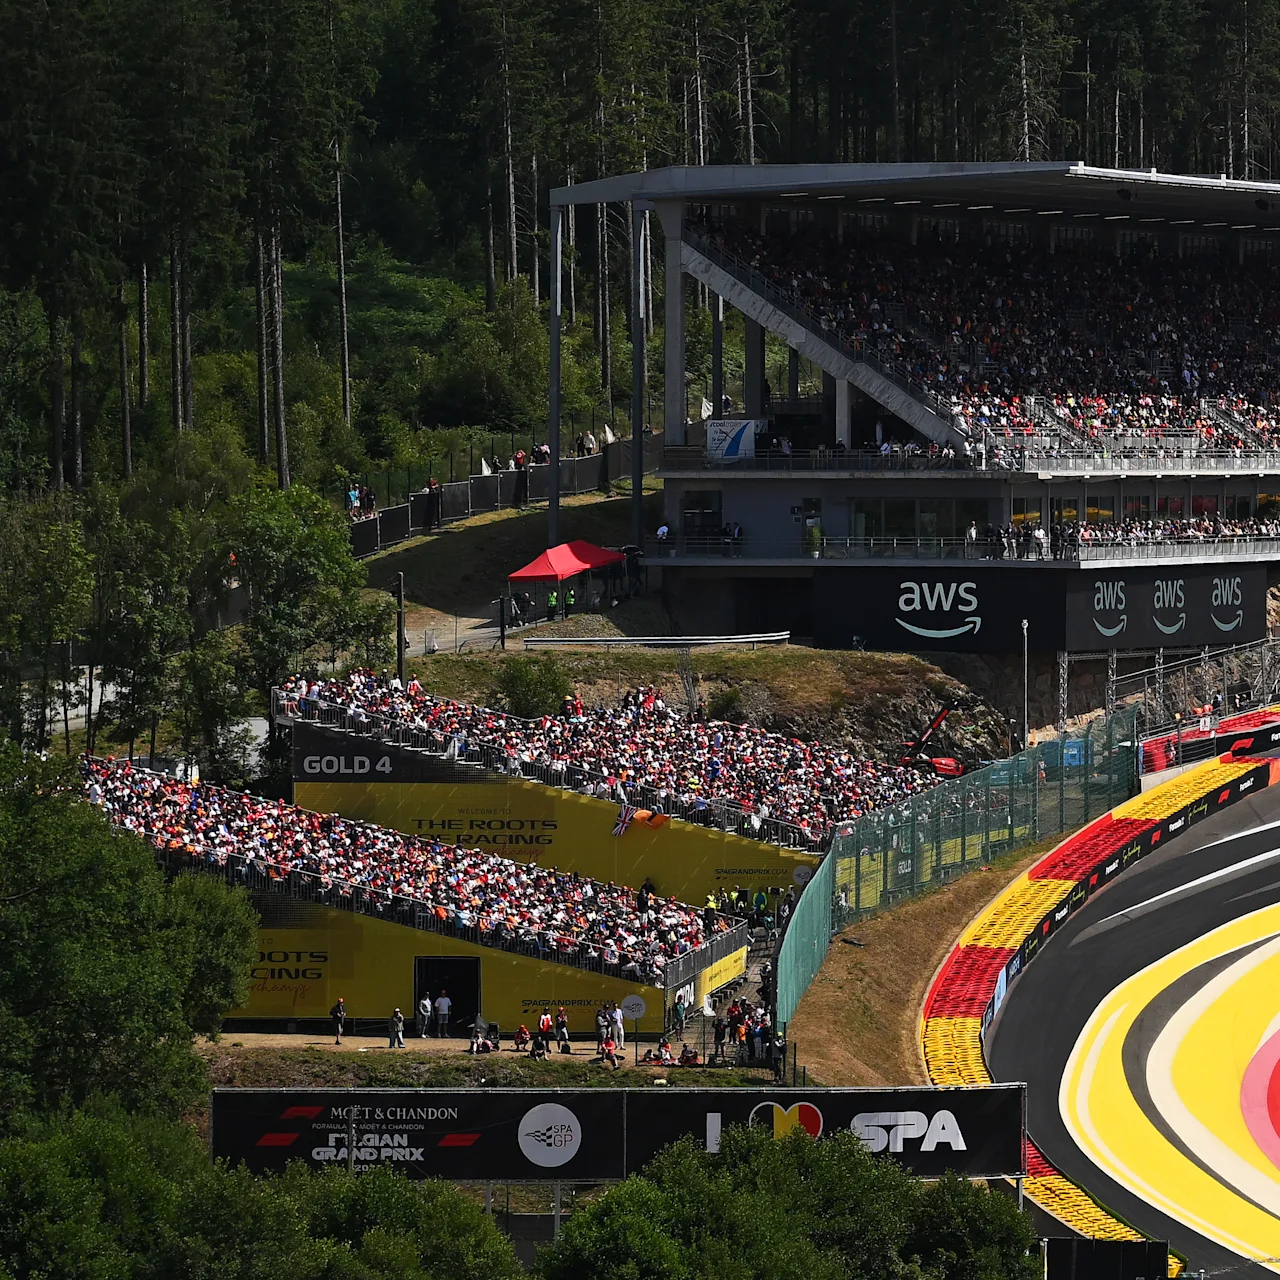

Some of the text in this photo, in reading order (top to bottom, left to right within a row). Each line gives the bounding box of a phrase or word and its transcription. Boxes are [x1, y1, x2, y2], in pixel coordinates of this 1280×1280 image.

[898, 582, 978, 612] aws
[1094, 581, 1126, 610] aws
[1154, 579, 1185, 609] aws
[1212, 577, 1242, 607] aws
[304, 756, 392, 774] GOLD 4
[412, 820, 558, 830] THE ROOTS
[456, 834, 552, 844] RACING
[260, 951, 328, 962] OTS
[250, 968, 322, 979] CING
[330, 1105, 458, 1120] MOËT & CHANDON
[553, 1125, 573, 1134] SPA
[850, 1110, 967, 1153] SPA
[553, 1135, 573, 1147] GP
[311, 1148, 425, 1160] GRAND PRIX
